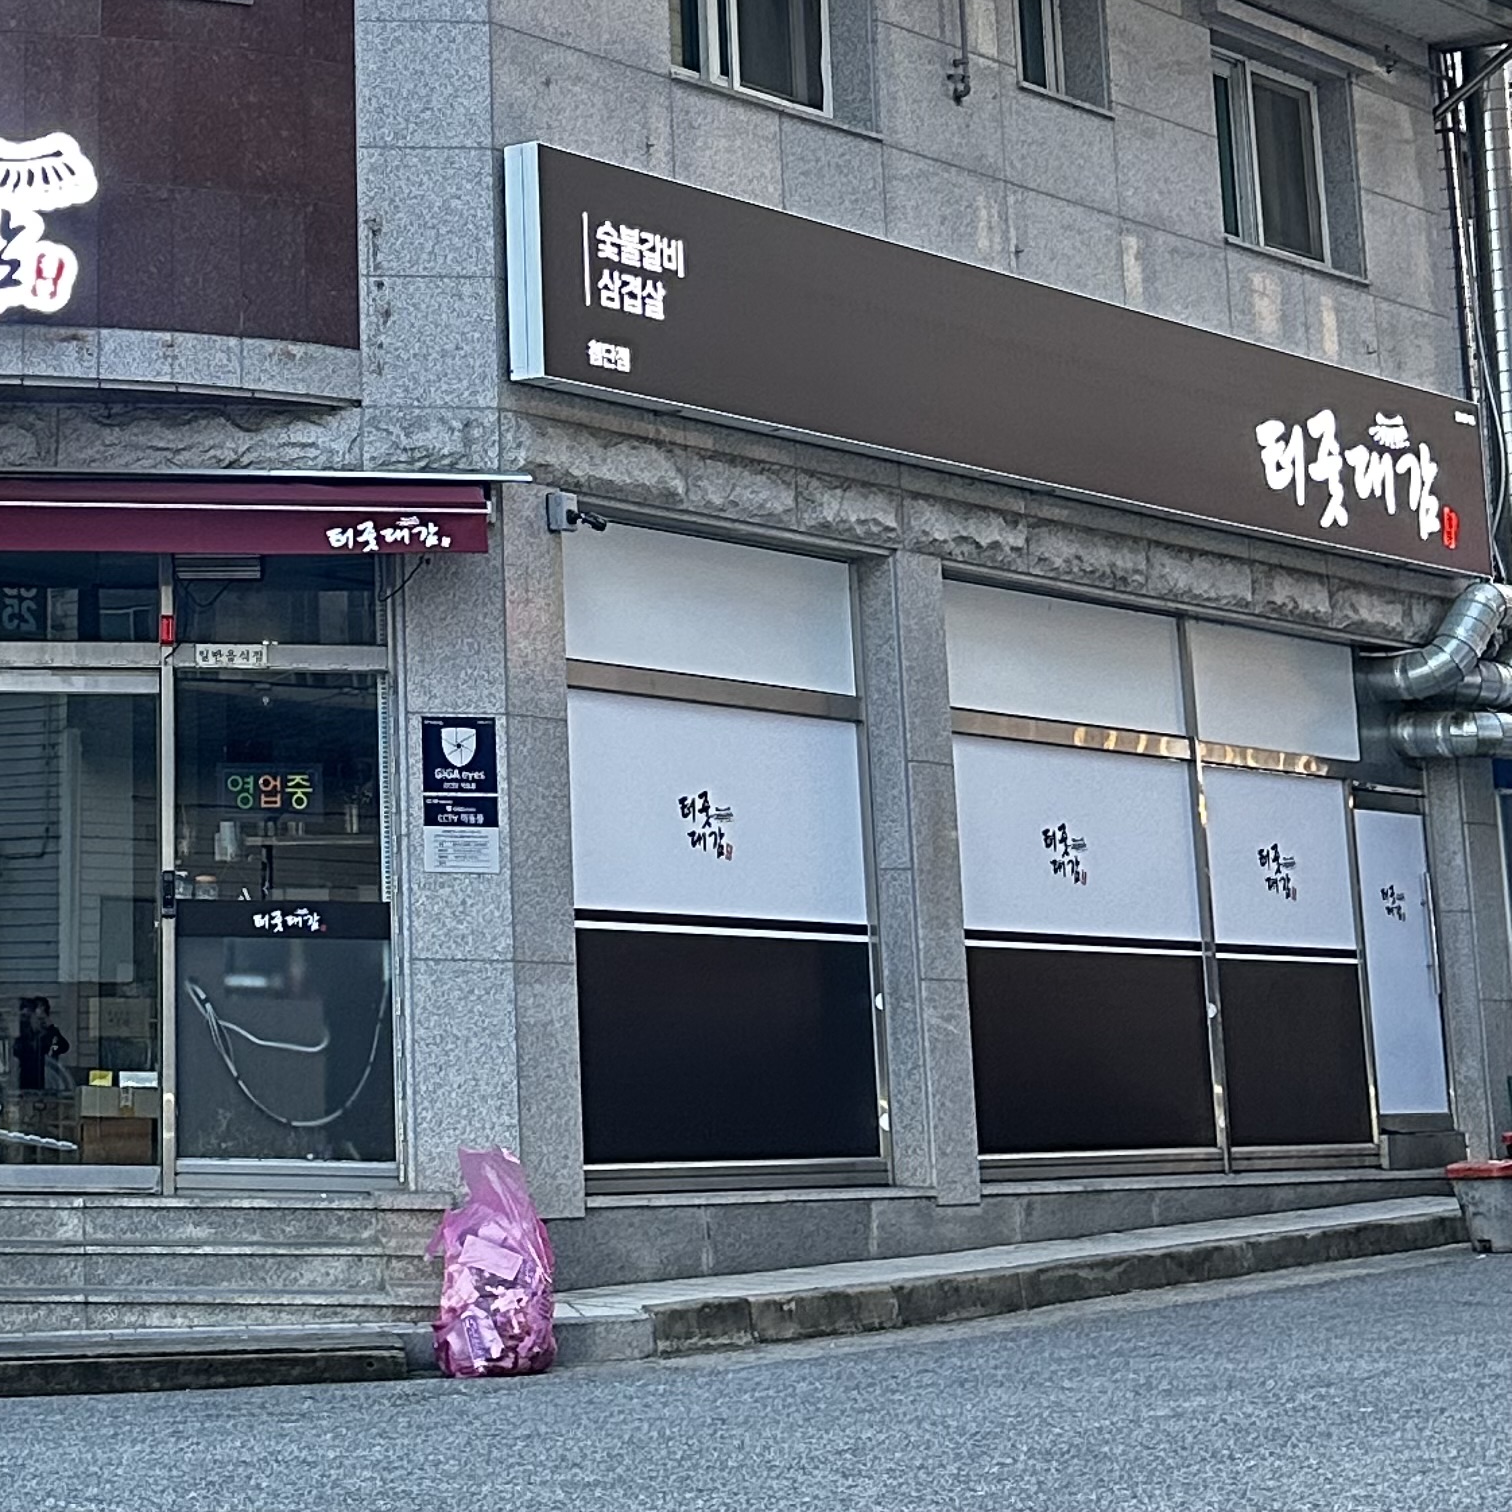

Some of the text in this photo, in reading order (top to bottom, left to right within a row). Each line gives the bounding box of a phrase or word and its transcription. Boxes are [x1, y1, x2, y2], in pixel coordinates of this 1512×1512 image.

[595, 220, 685, 278] 숯불갈비
[597, 268, 667, 320] 삼겹살
[199, 649, 263, 666] 일반음식점
[227, 774, 313, 810] 영업중
